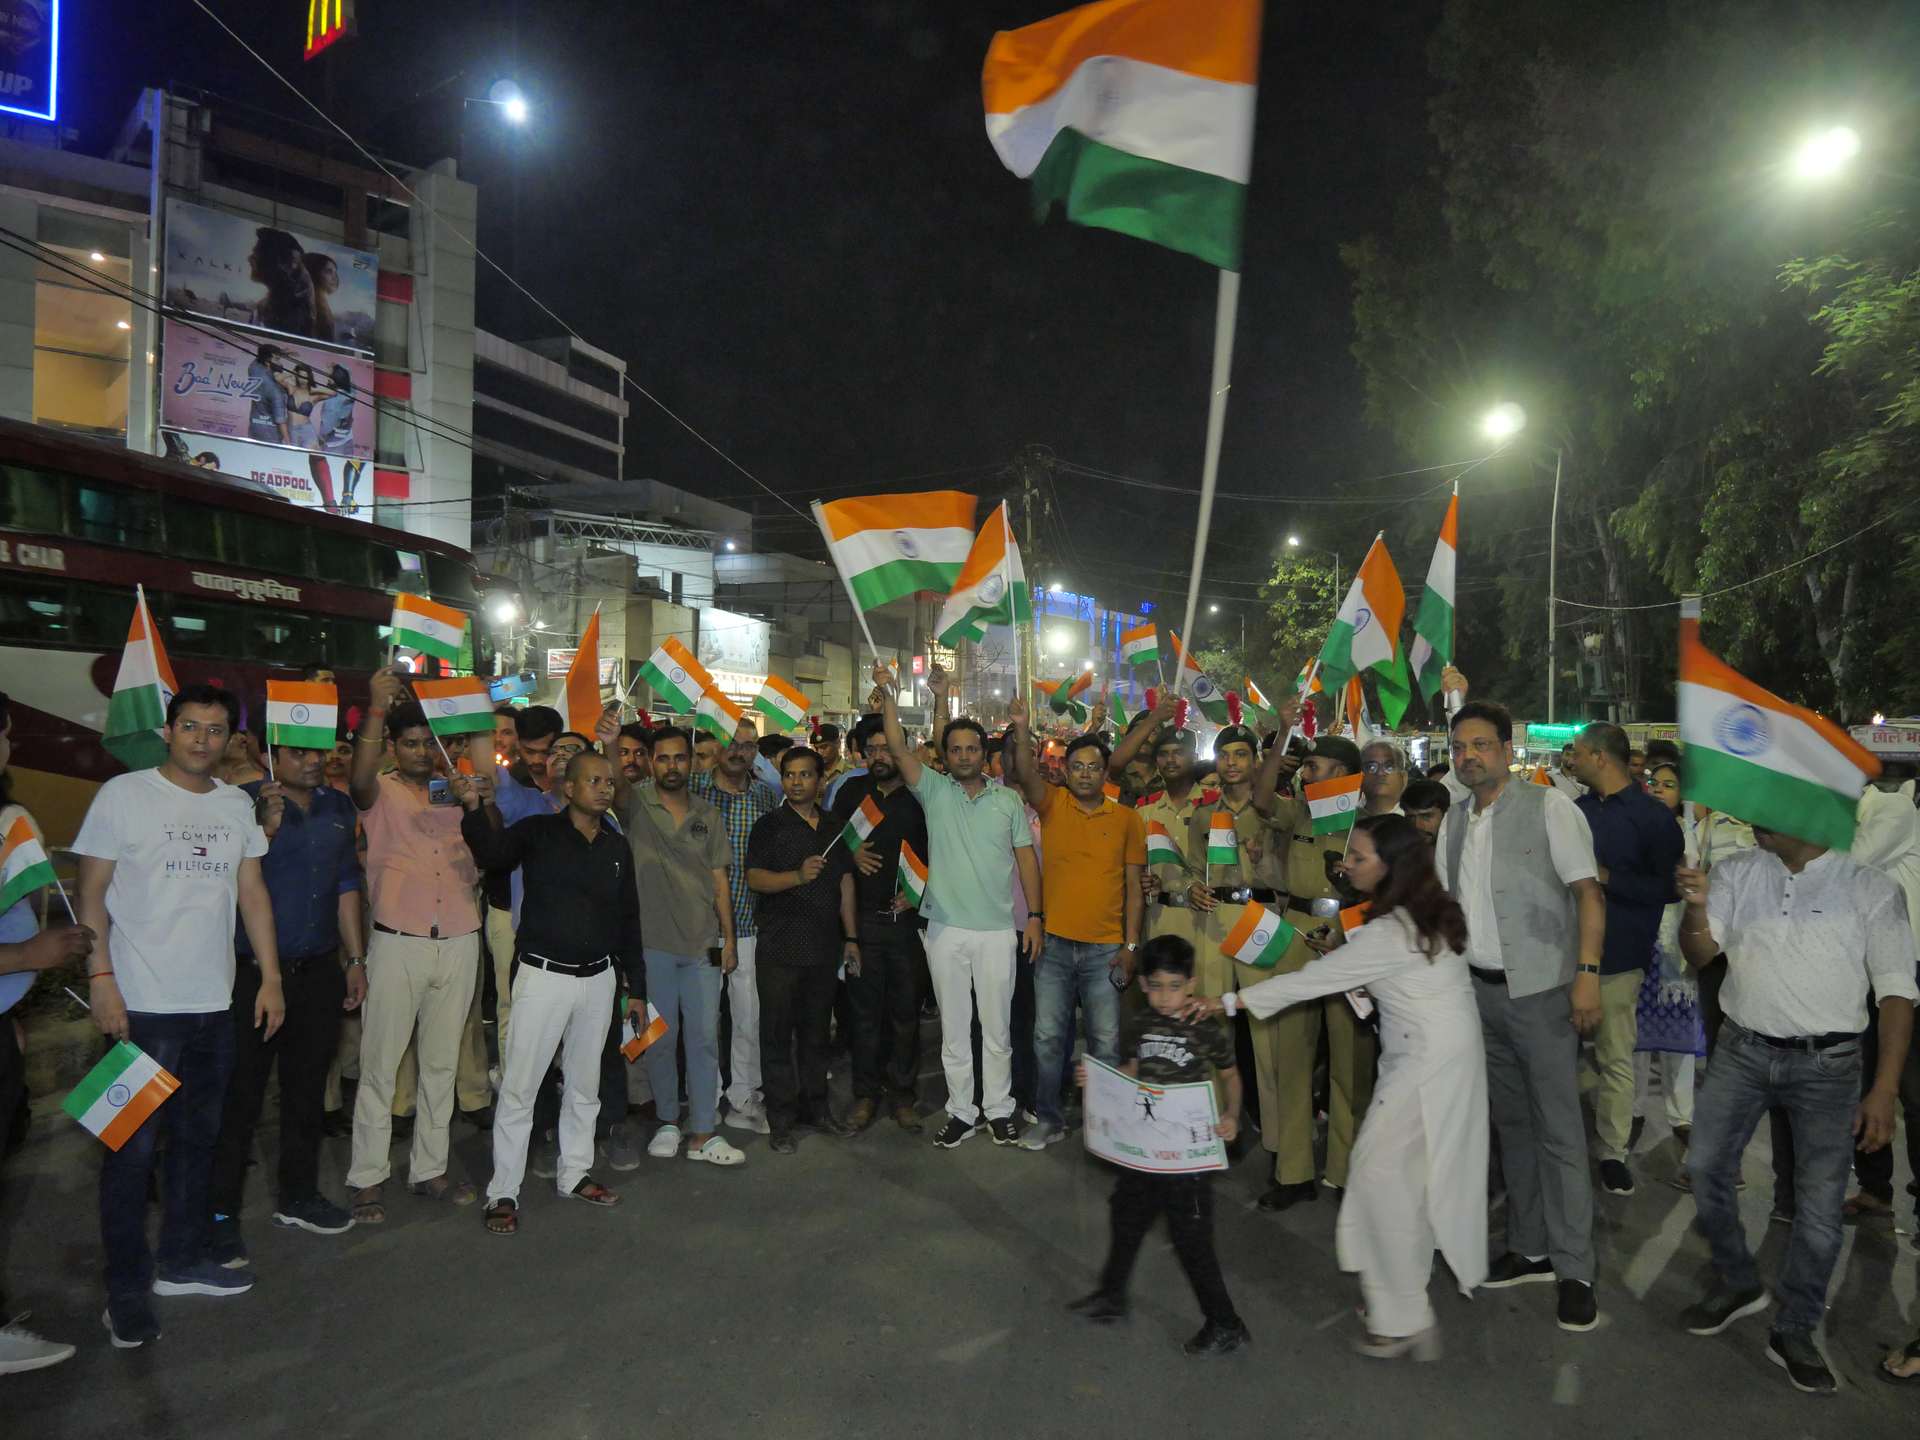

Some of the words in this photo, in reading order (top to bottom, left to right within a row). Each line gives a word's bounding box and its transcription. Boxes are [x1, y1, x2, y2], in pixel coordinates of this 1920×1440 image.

[178, 249, 243, 274] KALKI
[174, 361, 214, 396] Bad
[251, 470, 313, 492] DEADPOOL
[164, 831, 231, 843] TOMMY
[166, 860, 230, 873] HILFIGER
